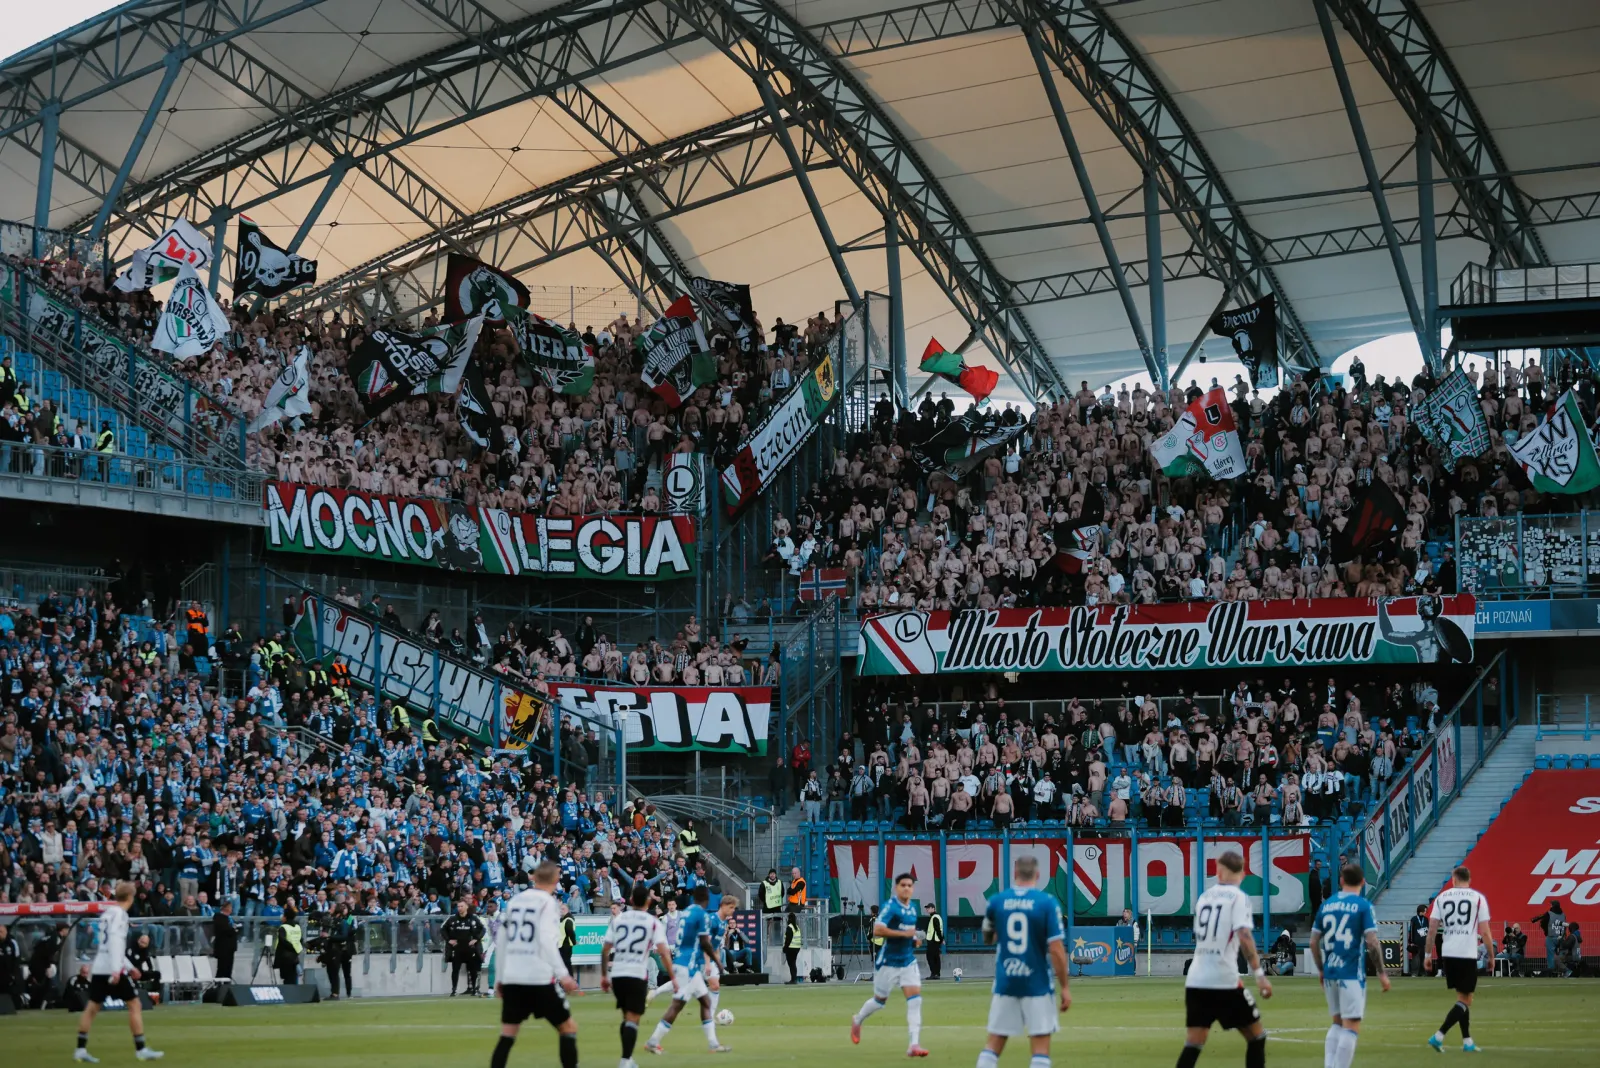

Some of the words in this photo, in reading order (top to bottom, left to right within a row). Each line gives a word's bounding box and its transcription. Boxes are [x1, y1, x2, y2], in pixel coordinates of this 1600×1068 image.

[294, 260, 315, 275] 16
[674, 471, 686, 493] L
[267, 484, 434, 560] MOCNO
[512, 515, 691, 576] LEGIA
[1493, 609, 1532, 624] POZNAŃ
[943, 608, 1051, 670] Miasto
[1207, 600, 1378, 664] Warszawa
[505, 907, 536, 943] 55
[1199, 904, 1223, 942] 91
[1442, 899, 1472, 927] 29
[615, 924, 648, 955] 22
[1007, 912, 1028, 955] 9
[1322, 913, 1353, 951] 24
[1078, 946, 1103, 958] LOTTO
[1118, 947, 1131, 961] LOTTO
[1385, 947, 1393, 960] 8
